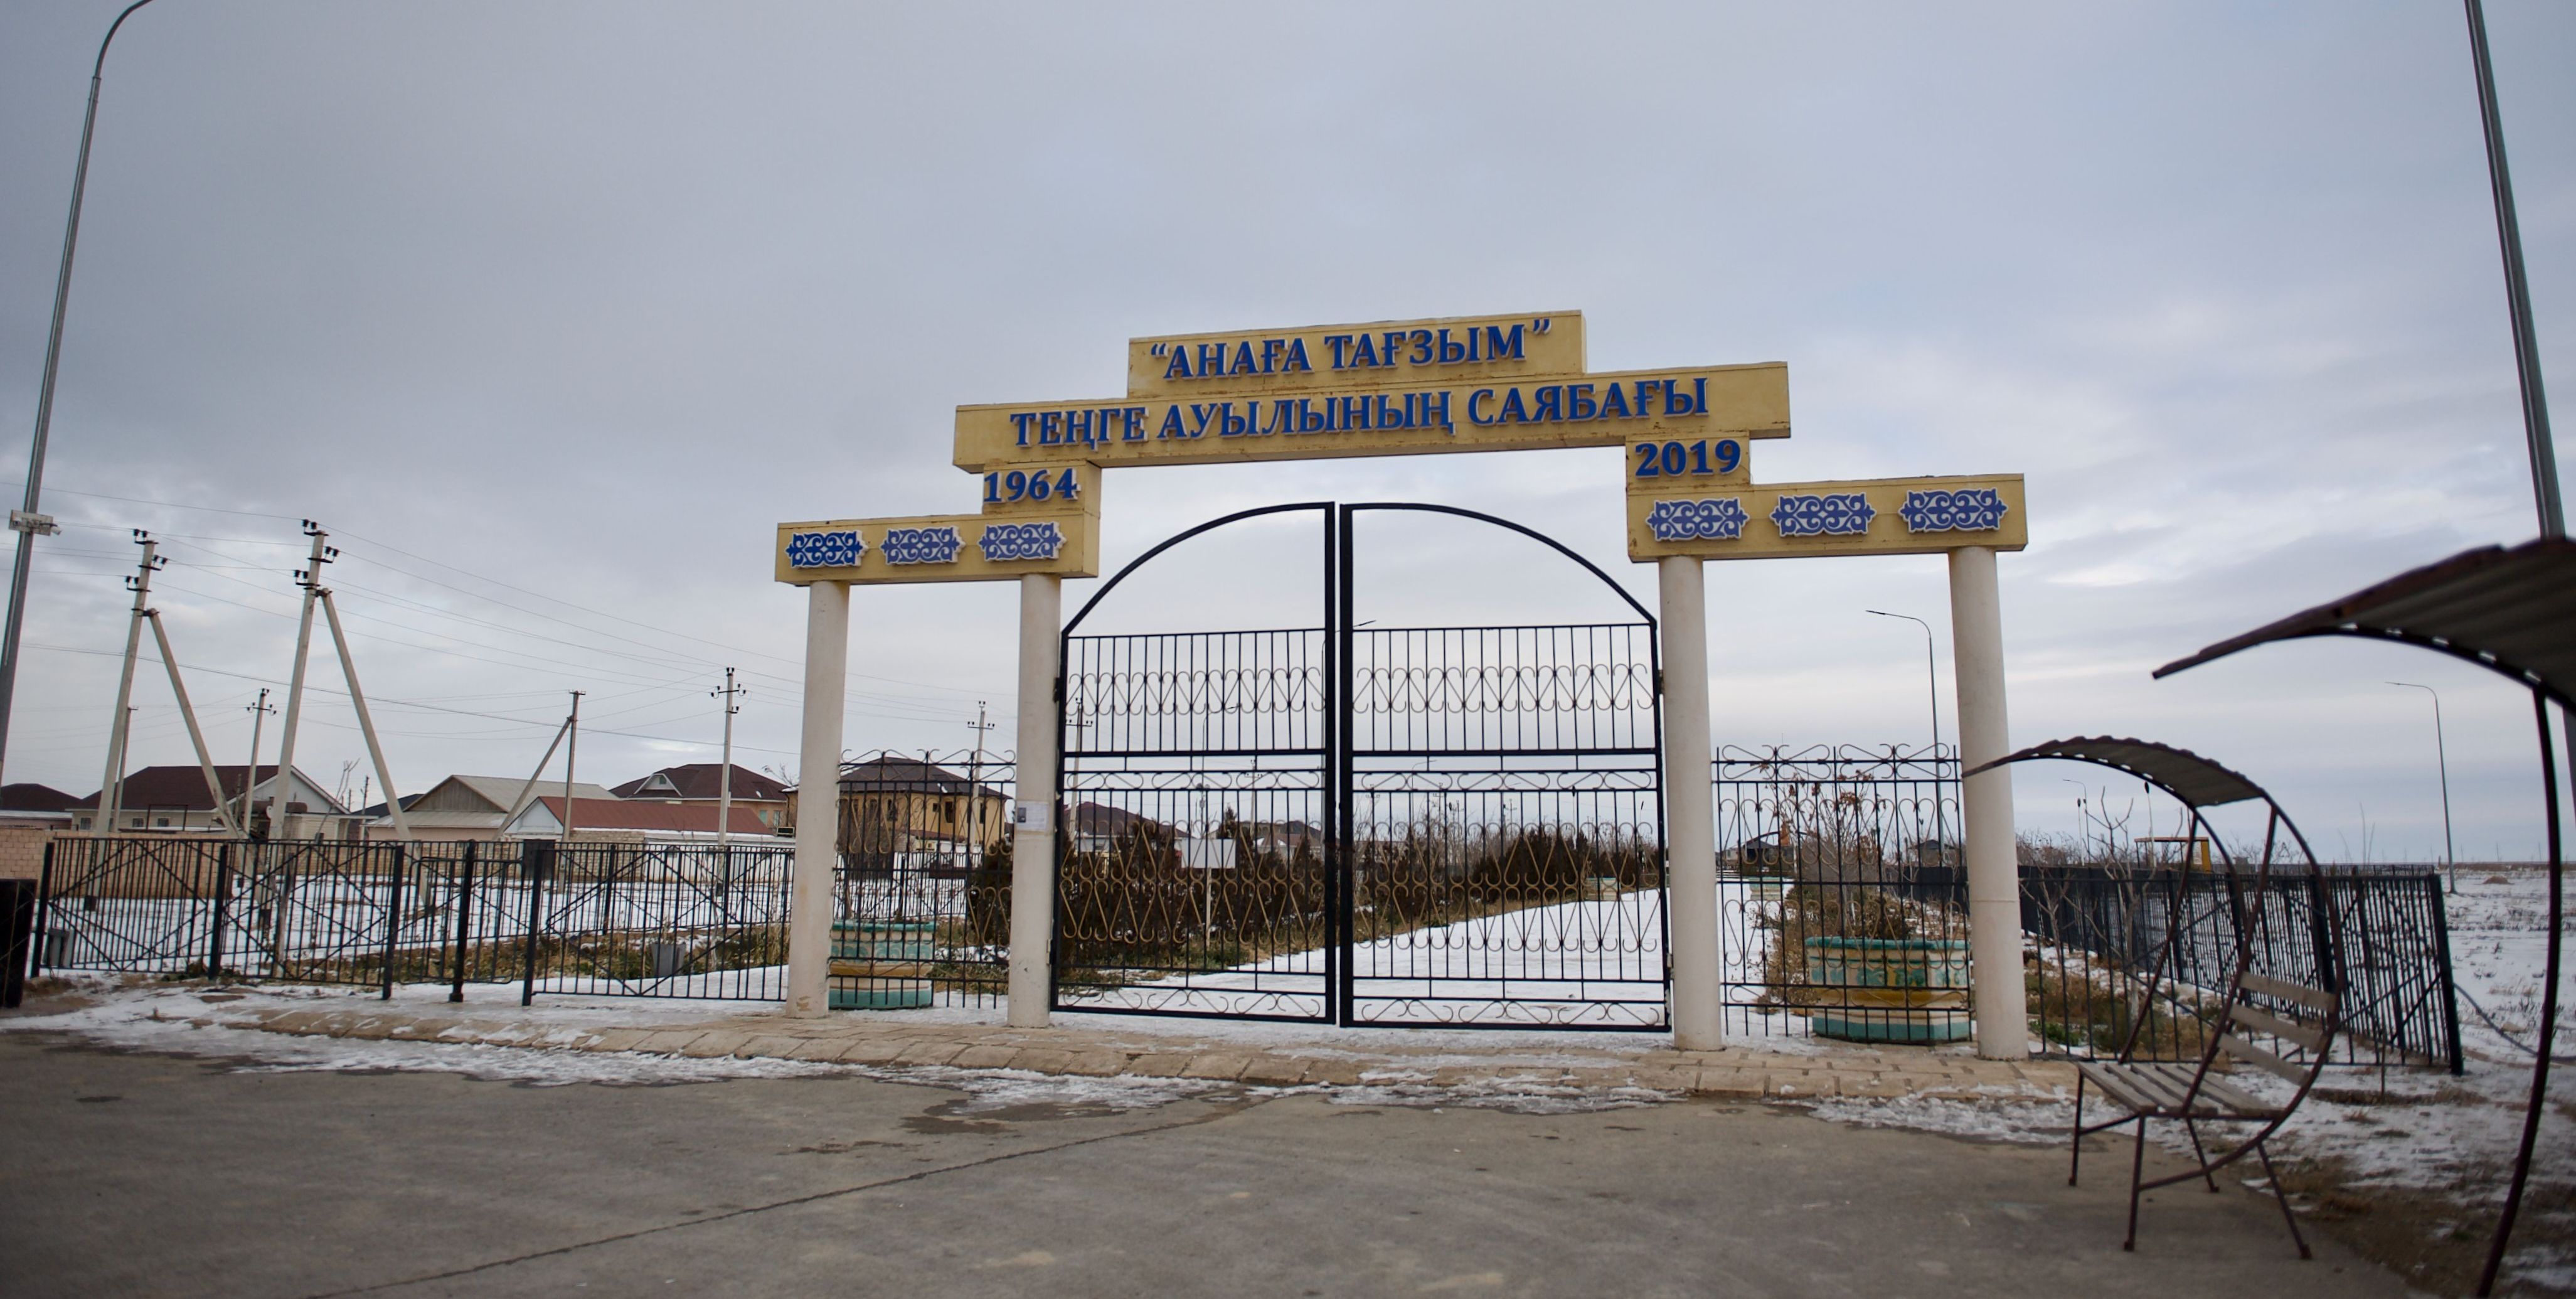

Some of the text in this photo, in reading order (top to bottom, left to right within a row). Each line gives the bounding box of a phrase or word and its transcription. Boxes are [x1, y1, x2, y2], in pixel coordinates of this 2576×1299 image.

[1010, 377, 1708, 451] ТЕҢГЕ АУЫЛЫНЫҢ САЯБАҒЫ
[1636, 439, 1742, 476] 2019
[983, 468, 1081, 503] 1964
